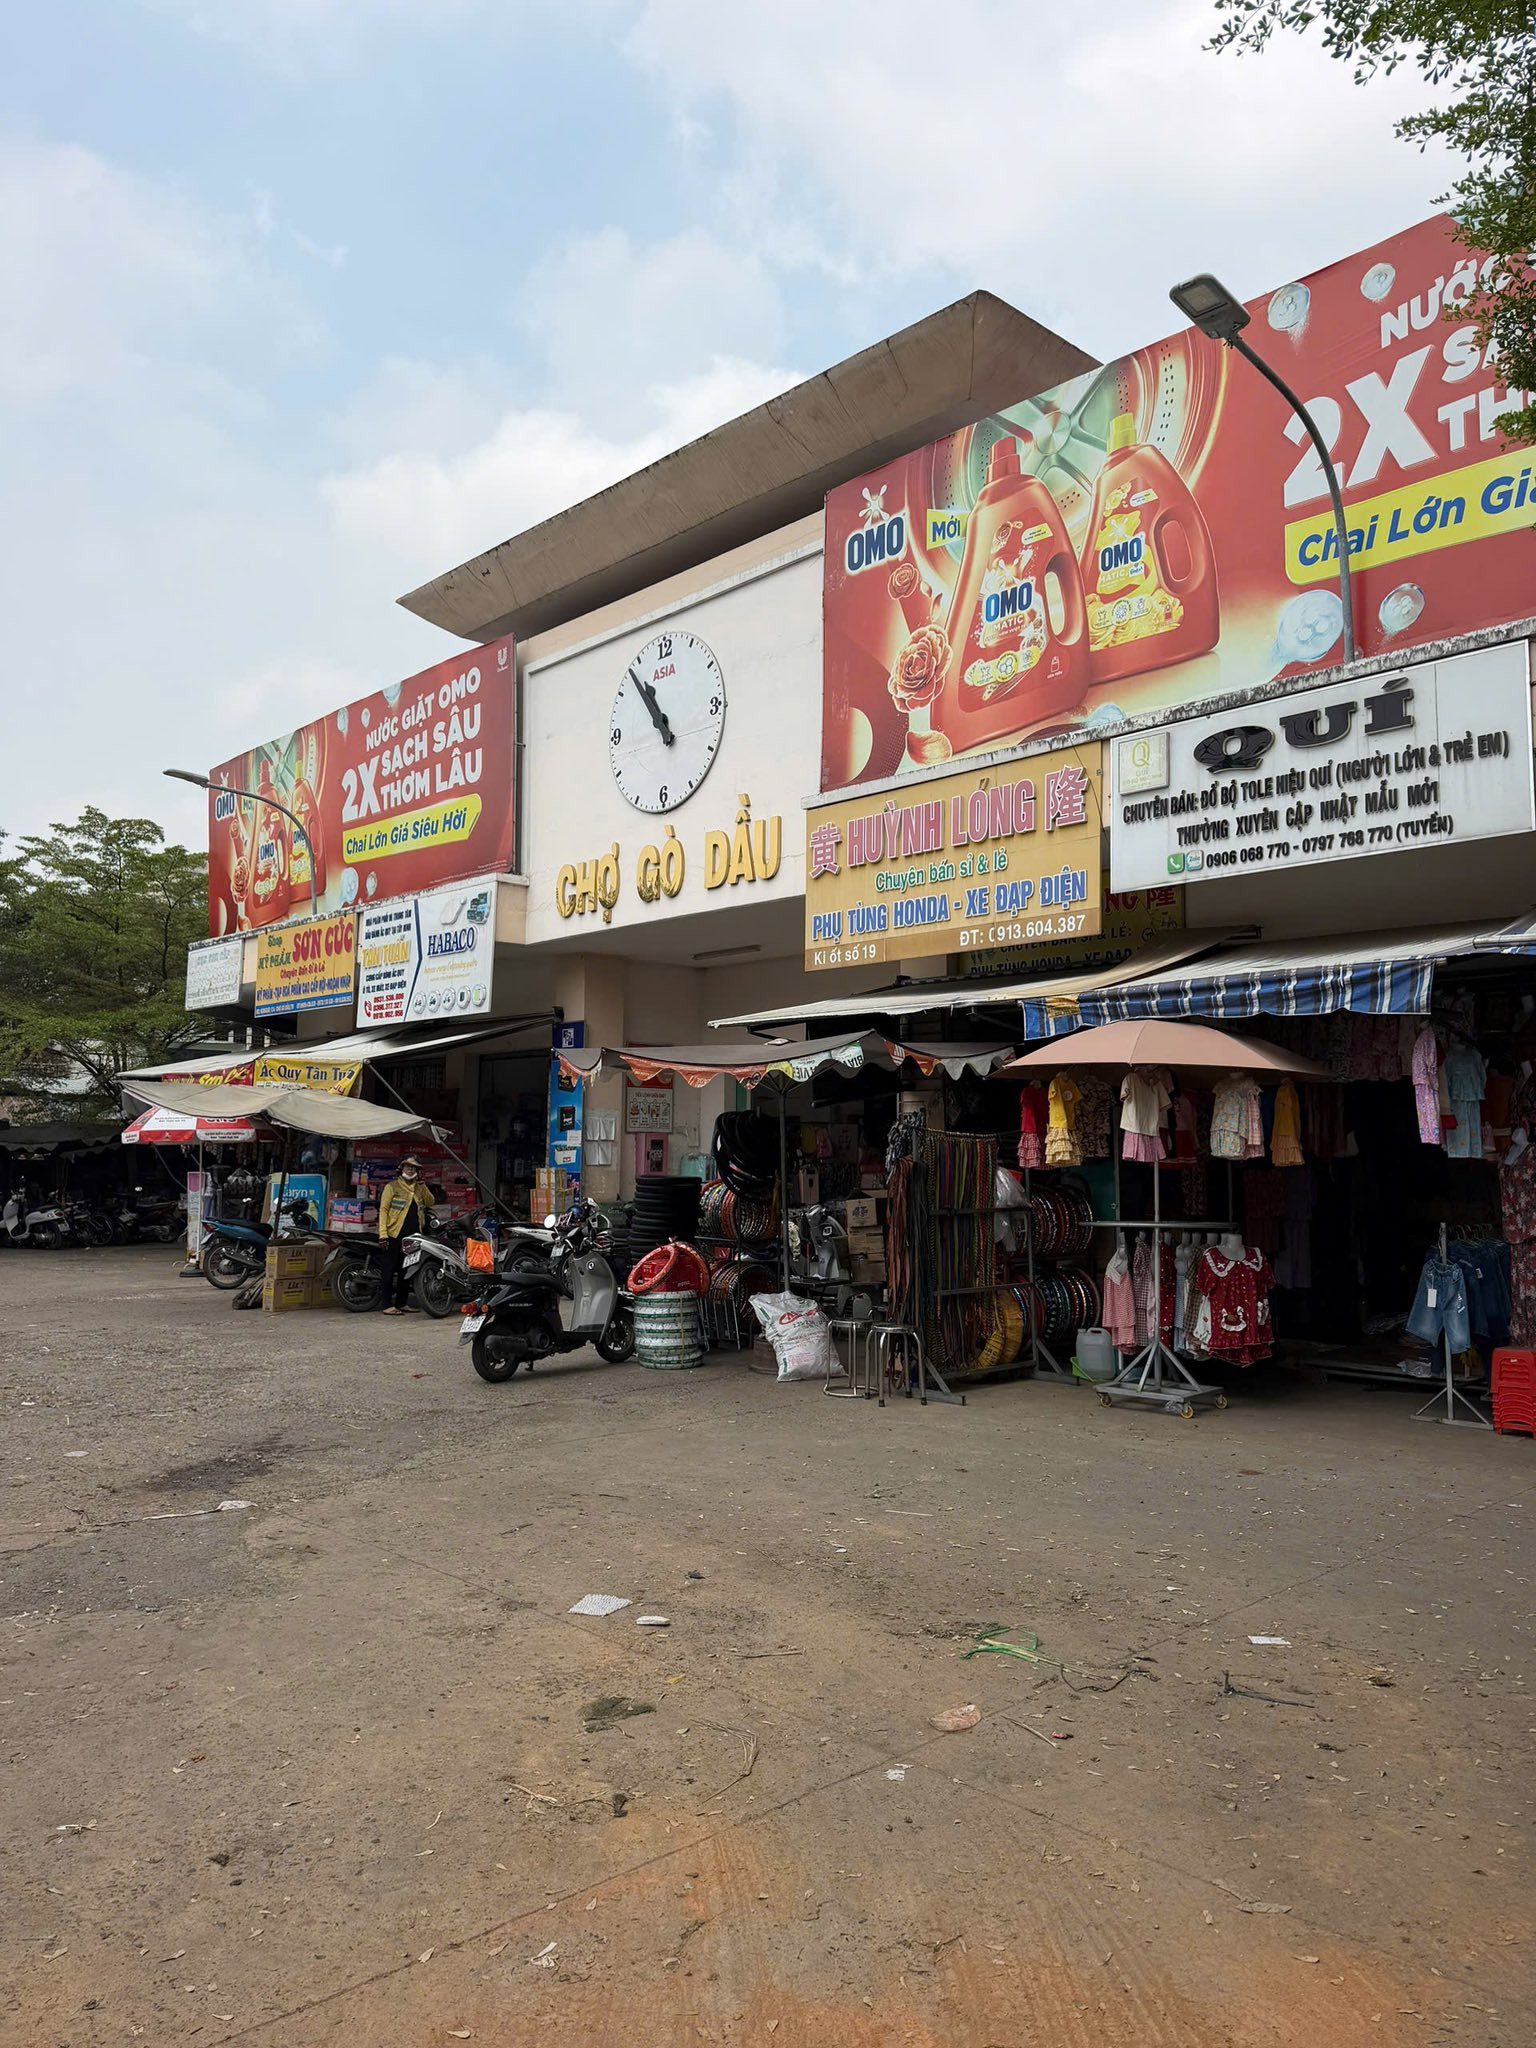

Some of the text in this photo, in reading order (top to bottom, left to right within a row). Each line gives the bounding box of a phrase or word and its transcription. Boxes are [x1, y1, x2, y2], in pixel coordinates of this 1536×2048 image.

[1283, 344, 1439, 509] 2X
[846, 514, 905, 571] OMO
[931, 514, 962, 543] MỚI
[1298, 513, 1380, 567] Chai
[1387, 495, 1466, 545] Lớn
[1100, 537, 1142, 572] OMO
[985, 581, 1033, 623] OMO
[993, 616, 1024, 632] MATIC
[657, 638, 672, 660] 12
[653, 663, 676, 682] ASIA
[366, 666, 481, 751] NƯỚC GIẶT OMO
[709, 696, 719, 716] 3
[1193, 676, 1415, 774] QUÍ
[381, 702, 481, 777] SẠCH SÂU
[613, 728, 621, 745] 9
[341, 755, 382, 824] 2X
[381, 747, 483, 811] THƠM LÂU
[659, 785, 668, 805] 6
[1123, 794, 1169, 824] CHUYÊN
[1221, 779, 1238, 809] BỘ
[1241, 777, 1273, 802] TOLE
[1276, 767, 1305, 798] HIỆU
[1336, 749, 1391, 788] (NGƯỜI
[1428, 744, 1441, 768] &
[1477, 730, 1510, 759] EM)
[216, 793, 235, 819] OMO
[1177, 817, 1229, 846] THƯỜNG
[1236, 806, 1280, 836] XUYÊN
[1285, 800, 1313, 832] CẬP
[1320, 792, 1358, 824] NHẬT
[1365, 779, 1399, 814] MẪU
[260, 842, 275, 861] OMO
[346, 807, 467, 854] Chai Lớn Giá Siêu Hời
[847, 800, 944, 867] HUỲNH
[1206, 853, 1237, 868] 0906
[1240, 846, 1264, 863] 068
[1267, 841, 1290, 859] 770
[1302, 834, 1335, 853] 0797
[1339, 829, 1364, 848] 768
[1367, 825, 1393, 844] 770
[556, 793, 782, 923] CHỢ GÒ DẦU
[876, 866, 925, 892] Chuyên
[977, 854, 989, 875] &
[812, 911, 842, 943] PHỤ
[847, 900, 887, 935] TÙNG
[893, 893, 949, 928] HONDA
[965, 886, 989, 918] XE
[995, 878, 1033, 918] ĐẠP
[1039, 864, 1087, 910] ĐIỆN
[293, 917, 353, 963] SƠN CÚC
[427, 927, 475, 956] HABACO
[959, 914, 1086, 947] ĐT: 0913.604.387
[814, 944, 876, 965] Ki ốt số 19
[260, 1060, 274, 1077] Ắc
[277, 1065, 302, 1081] Quy
[306, 1065, 327, 1080] Tân
